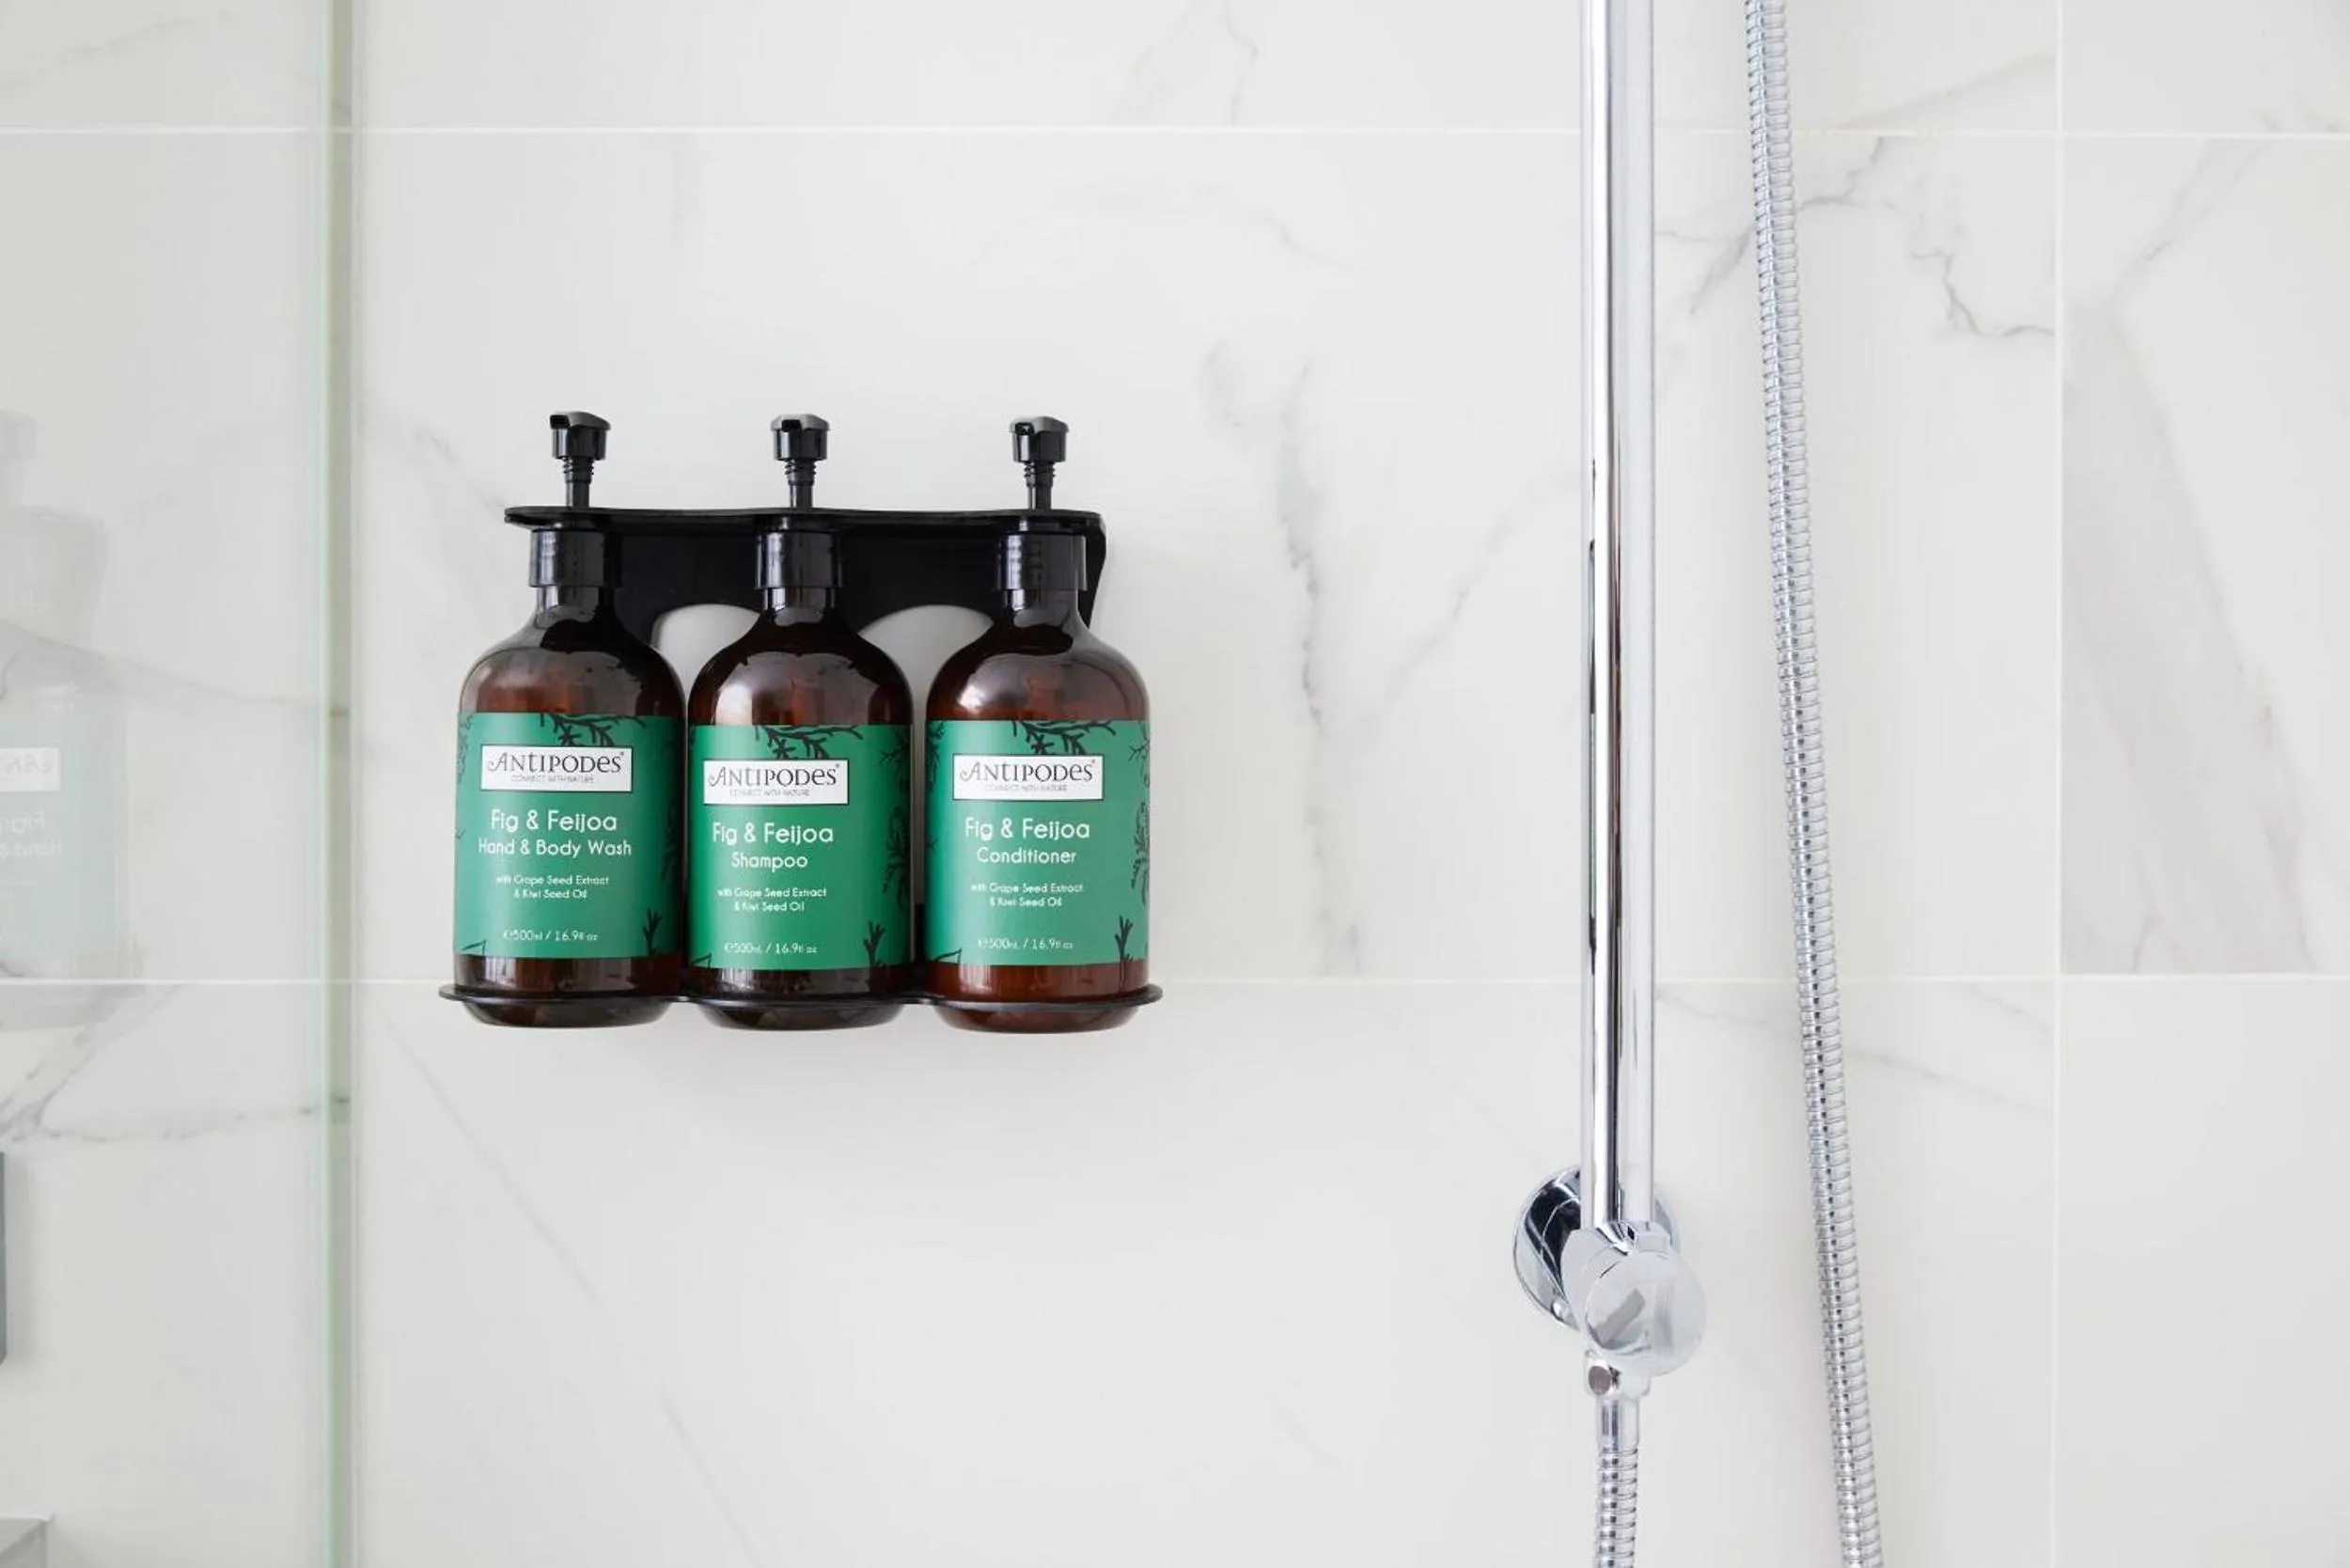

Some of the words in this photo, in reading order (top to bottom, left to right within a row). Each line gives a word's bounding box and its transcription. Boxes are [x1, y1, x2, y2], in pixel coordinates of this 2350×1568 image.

[491, 809, 519, 832] Fig
[525, 809, 540, 829] &
[547, 809, 618, 833] Feijoa
[713, 823, 737, 845] Fig
[744, 823, 757, 842] &
[763, 823, 834, 845] Feijoa
[965, 818, 994, 840] Fig
[1001, 818, 1014, 839] &
[1022, 818, 1090, 840] Feijoa
[478, 839, 514, 855] Hand
[520, 839, 530, 855] &
[536, 839, 580, 858] Body
[588, 839, 632, 856] Wash
[977, 847, 1076, 864] Conditioner
[731, 853, 808, 872] Shampoo
[513, 874, 544, 886] Grape
[546, 874, 572, 885] Seed
[576, 874, 609, 885] Extract
[522, 888, 541, 899] Kiwi
[543, 888, 570, 899] Seed
[572, 888, 588, 899] Oil
[717, 888, 732, 898] with
[734, 888, 762, 901] Grape
[764, 888, 790, 899] Seed
[792, 888, 827, 899] Extract
[989, 884, 1019, 896] Grape
[1023, 884, 1047, 894] Seed
[1050, 884, 1083, 894] Extract
[761, 902, 787, 913] Seed
[790, 902, 805, 913] Oil
[1019, 897, 1044, 907] Seed
[1047, 897, 1062, 907] Oil
